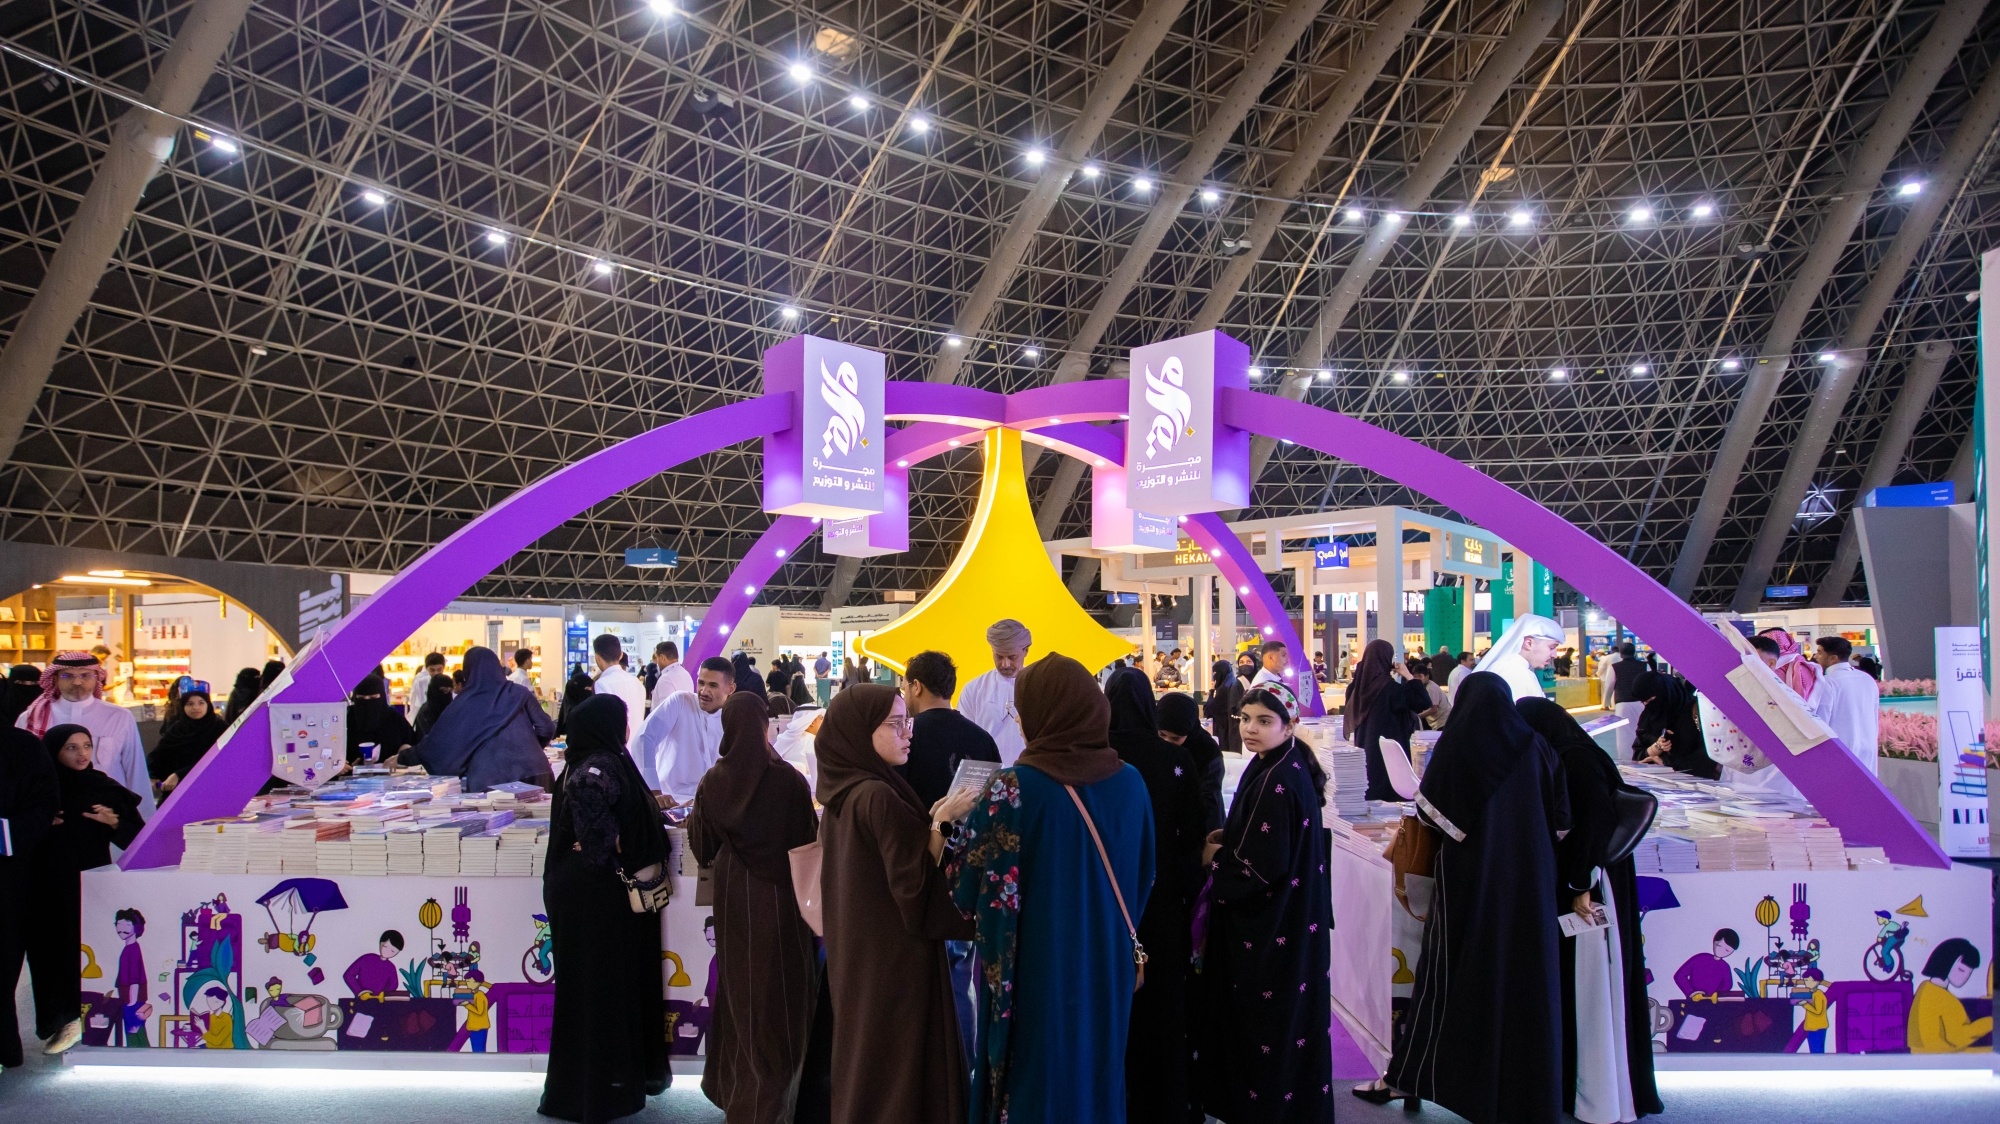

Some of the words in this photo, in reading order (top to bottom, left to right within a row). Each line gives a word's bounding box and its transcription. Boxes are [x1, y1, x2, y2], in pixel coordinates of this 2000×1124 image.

[812, 457, 875, 476] مجرة
[1136, 455, 1201, 473] مجرة
[812, 475, 843, 488] التوزيع
[850, 477, 875, 491] للنشر
[1136, 474, 1166, 489] التوزيع
[1174, 469, 1201, 485] للنشر
[1956, 667, 1977, 682] تقرأ
